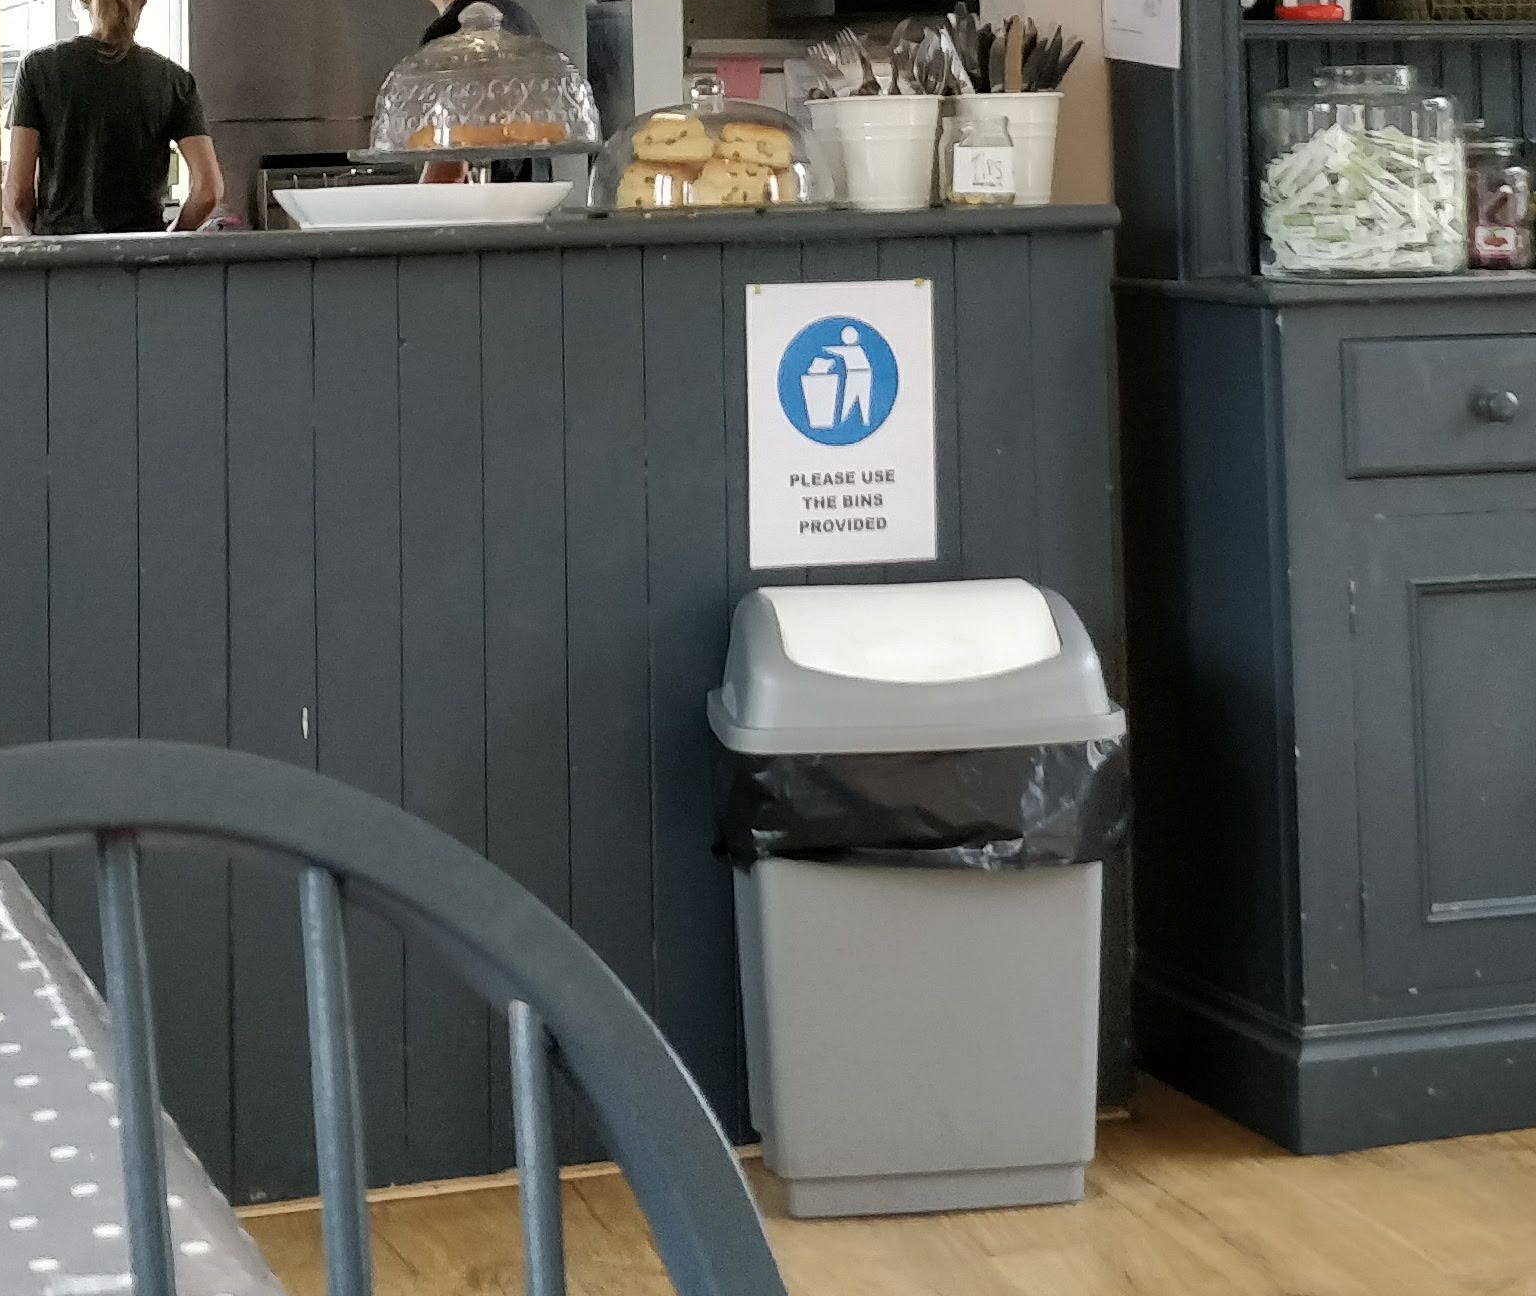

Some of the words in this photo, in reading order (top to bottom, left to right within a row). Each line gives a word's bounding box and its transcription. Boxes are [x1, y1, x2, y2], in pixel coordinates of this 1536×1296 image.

[789, 470, 857, 487] PLEASE
[861, 468, 896, 484] USE
[802, 495, 837, 510] THE
[842, 492, 884, 508] BINS
[799, 516, 888, 534] PROVIDED
